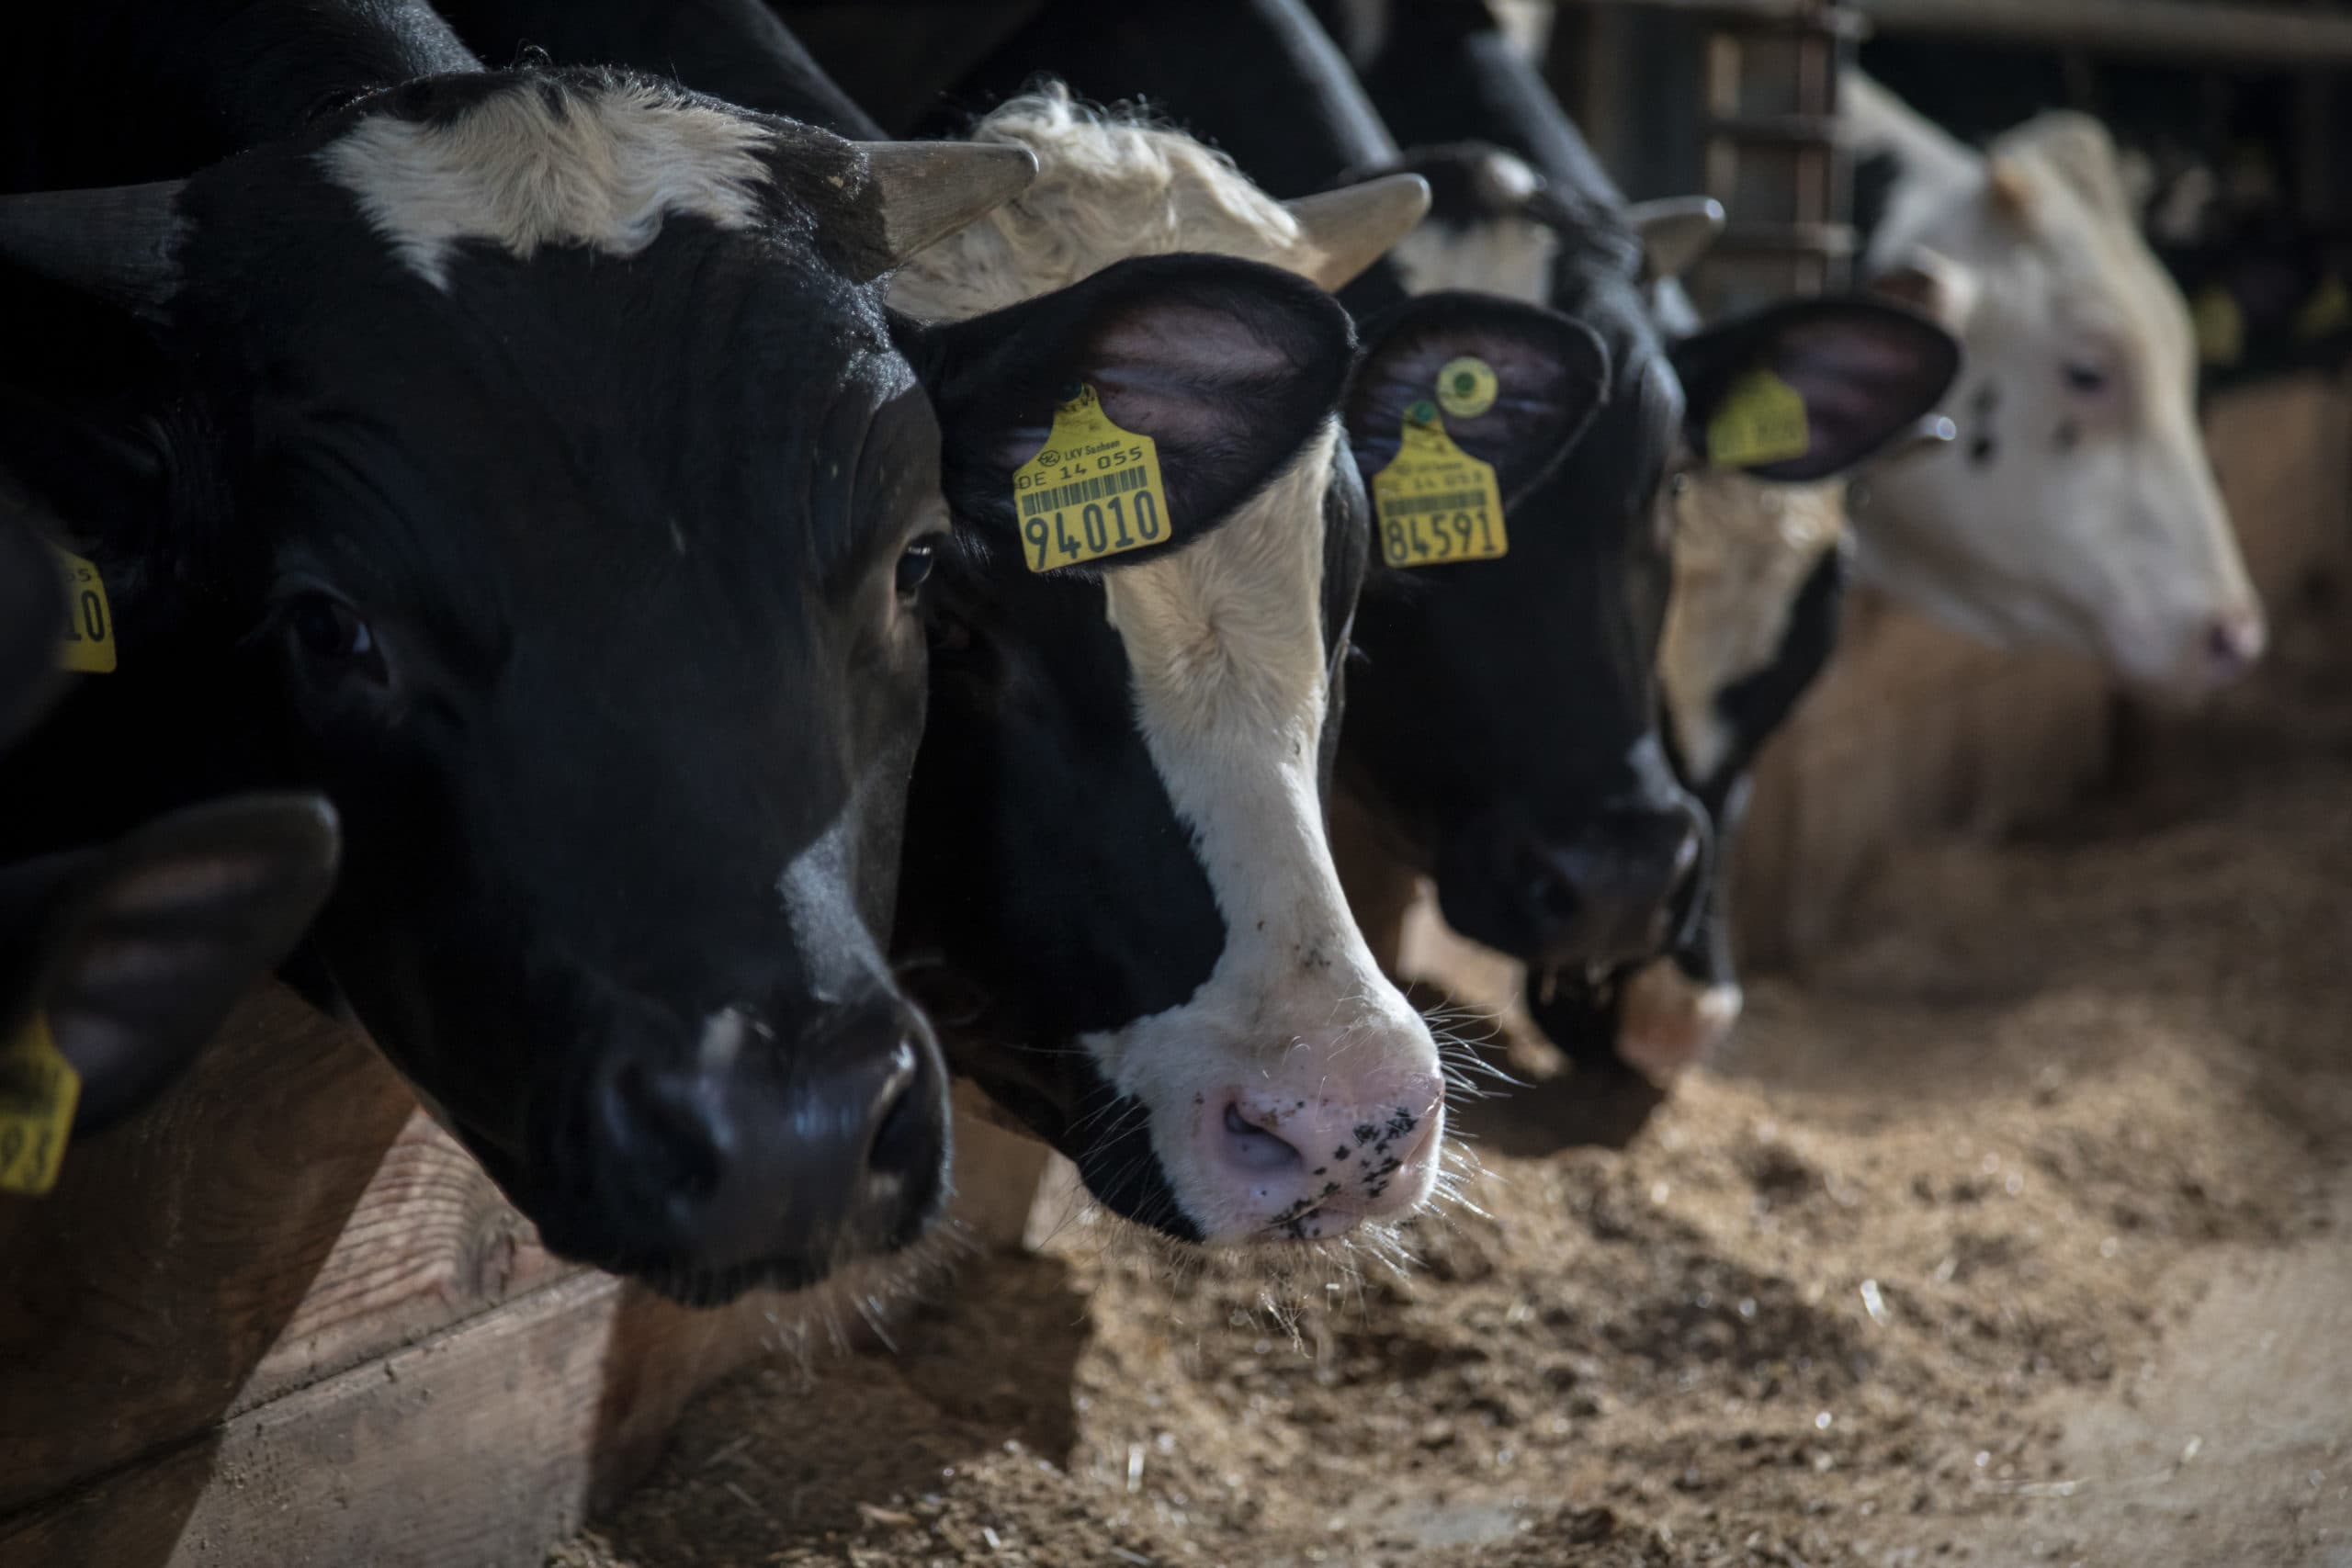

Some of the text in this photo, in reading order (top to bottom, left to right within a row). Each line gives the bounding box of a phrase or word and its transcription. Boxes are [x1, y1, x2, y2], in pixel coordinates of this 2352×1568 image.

[1059, 463, 1087, 480] 14
[1097, 446, 1143, 470] 055
[1064, 446, 1083, 461] LKV
[1024, 490, 1159, 570] 94010
[1385, 509, 1496, 562] 84591
